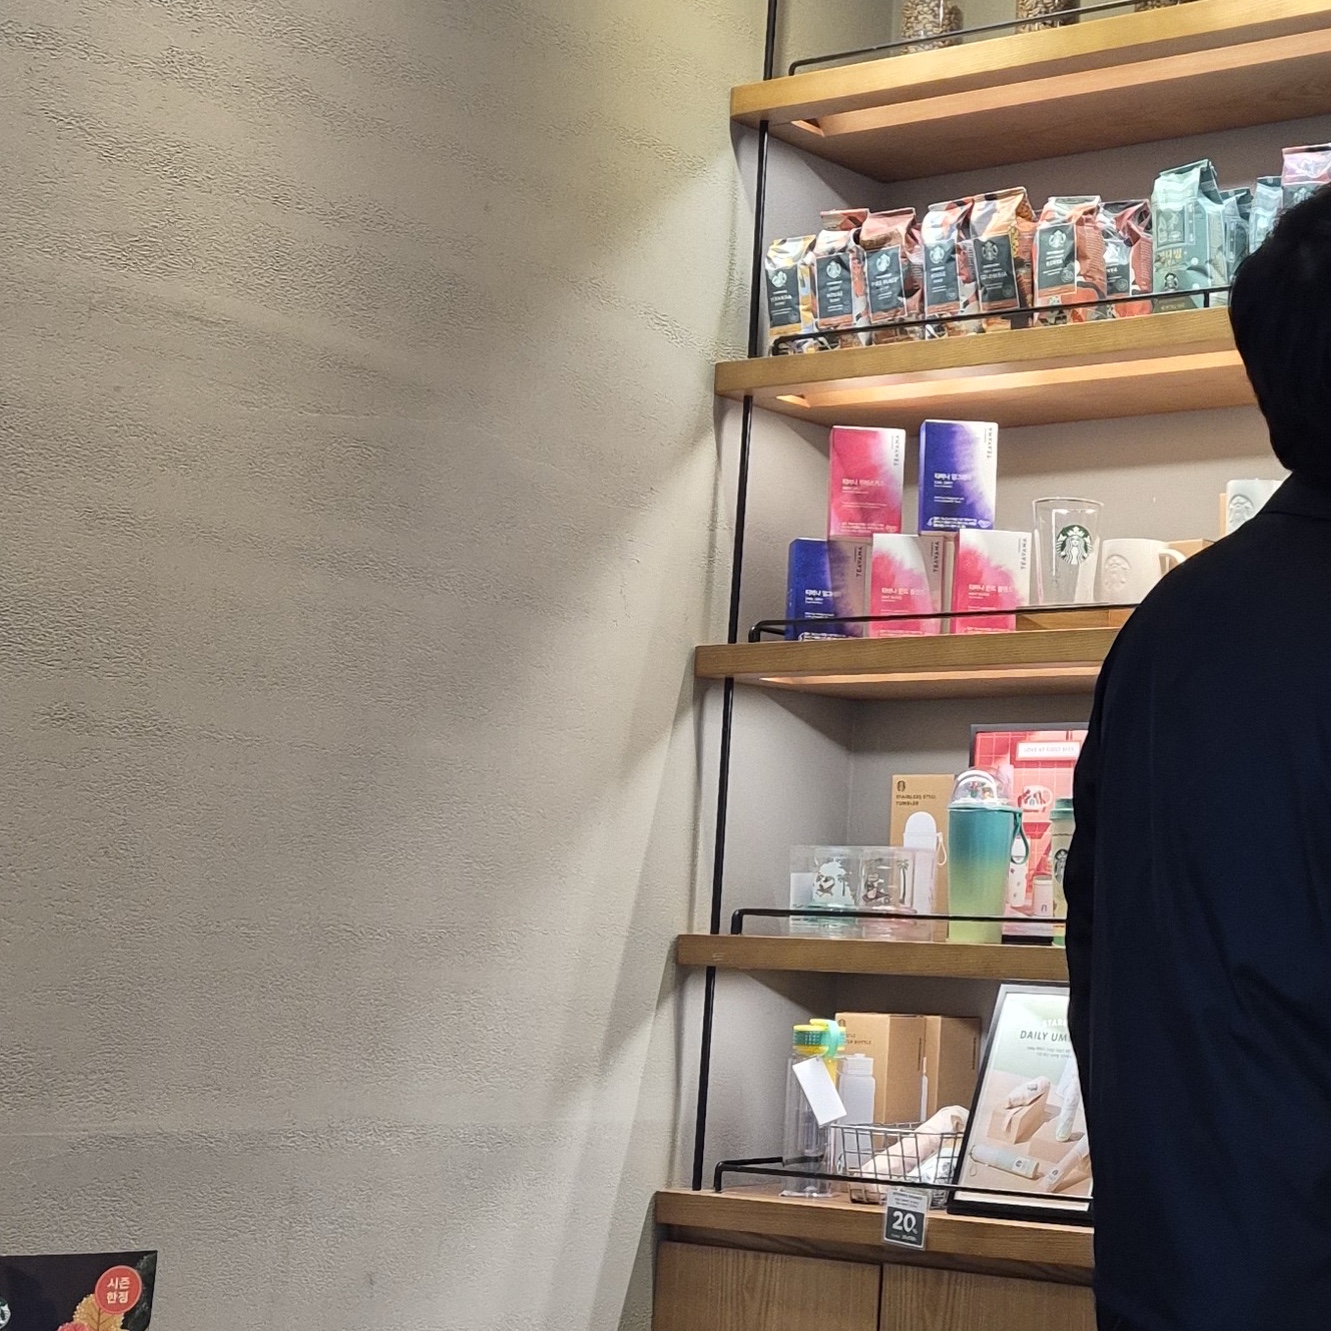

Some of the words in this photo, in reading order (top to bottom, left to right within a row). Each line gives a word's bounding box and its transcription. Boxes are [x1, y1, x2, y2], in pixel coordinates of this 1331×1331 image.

[932, 541, 940, 573] TEAVANA
[1020, 1030, 1049, 1041] DAILY
[1051, 1032, 1071, 1042] UM
[107, 1276, 130, 1289] 시즌
[106, 1291, 130, 1304] 한정
